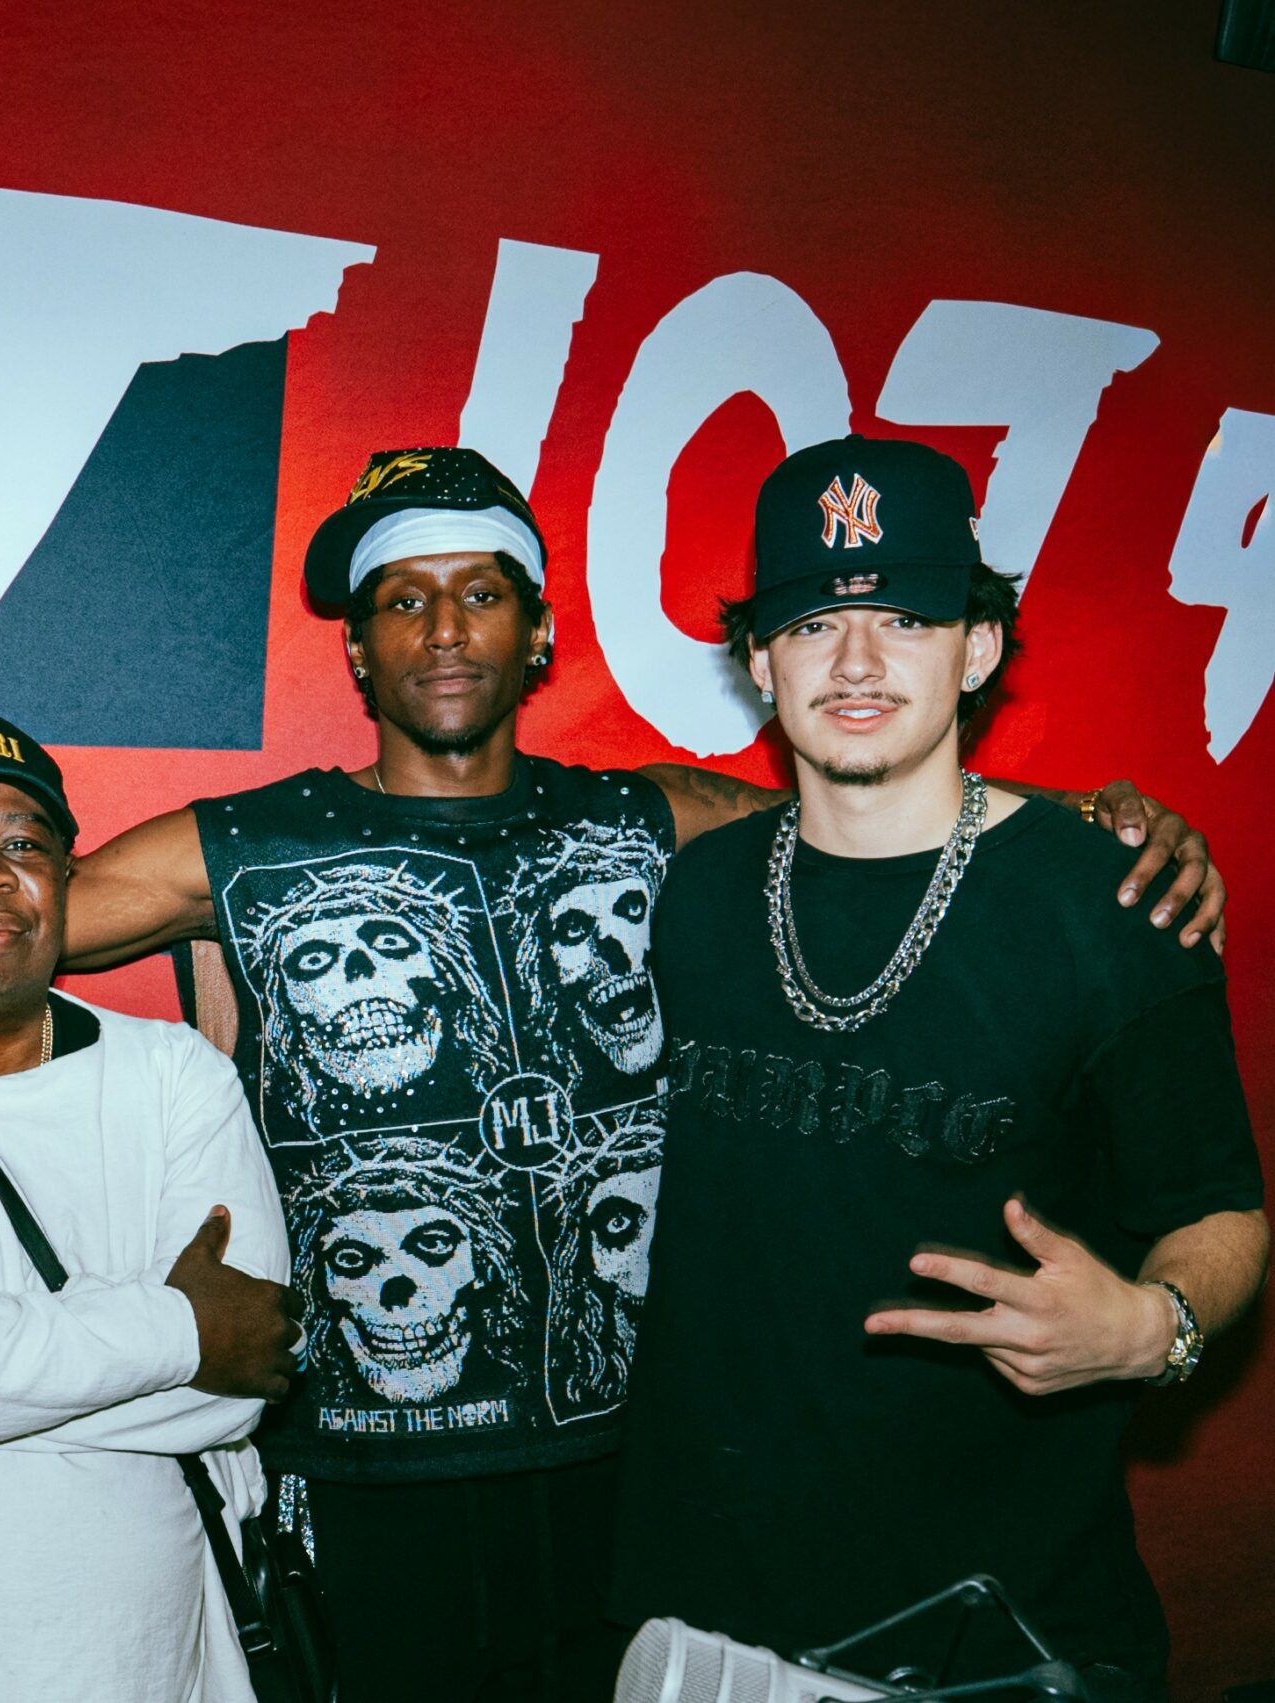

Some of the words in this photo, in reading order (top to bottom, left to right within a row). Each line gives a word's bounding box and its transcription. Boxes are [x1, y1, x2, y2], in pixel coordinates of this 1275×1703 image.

[818, 473, 884, 549] NY
[318, 1406, 399, 1433] AGAINST
[402, 1406, 444, 1432] THE
